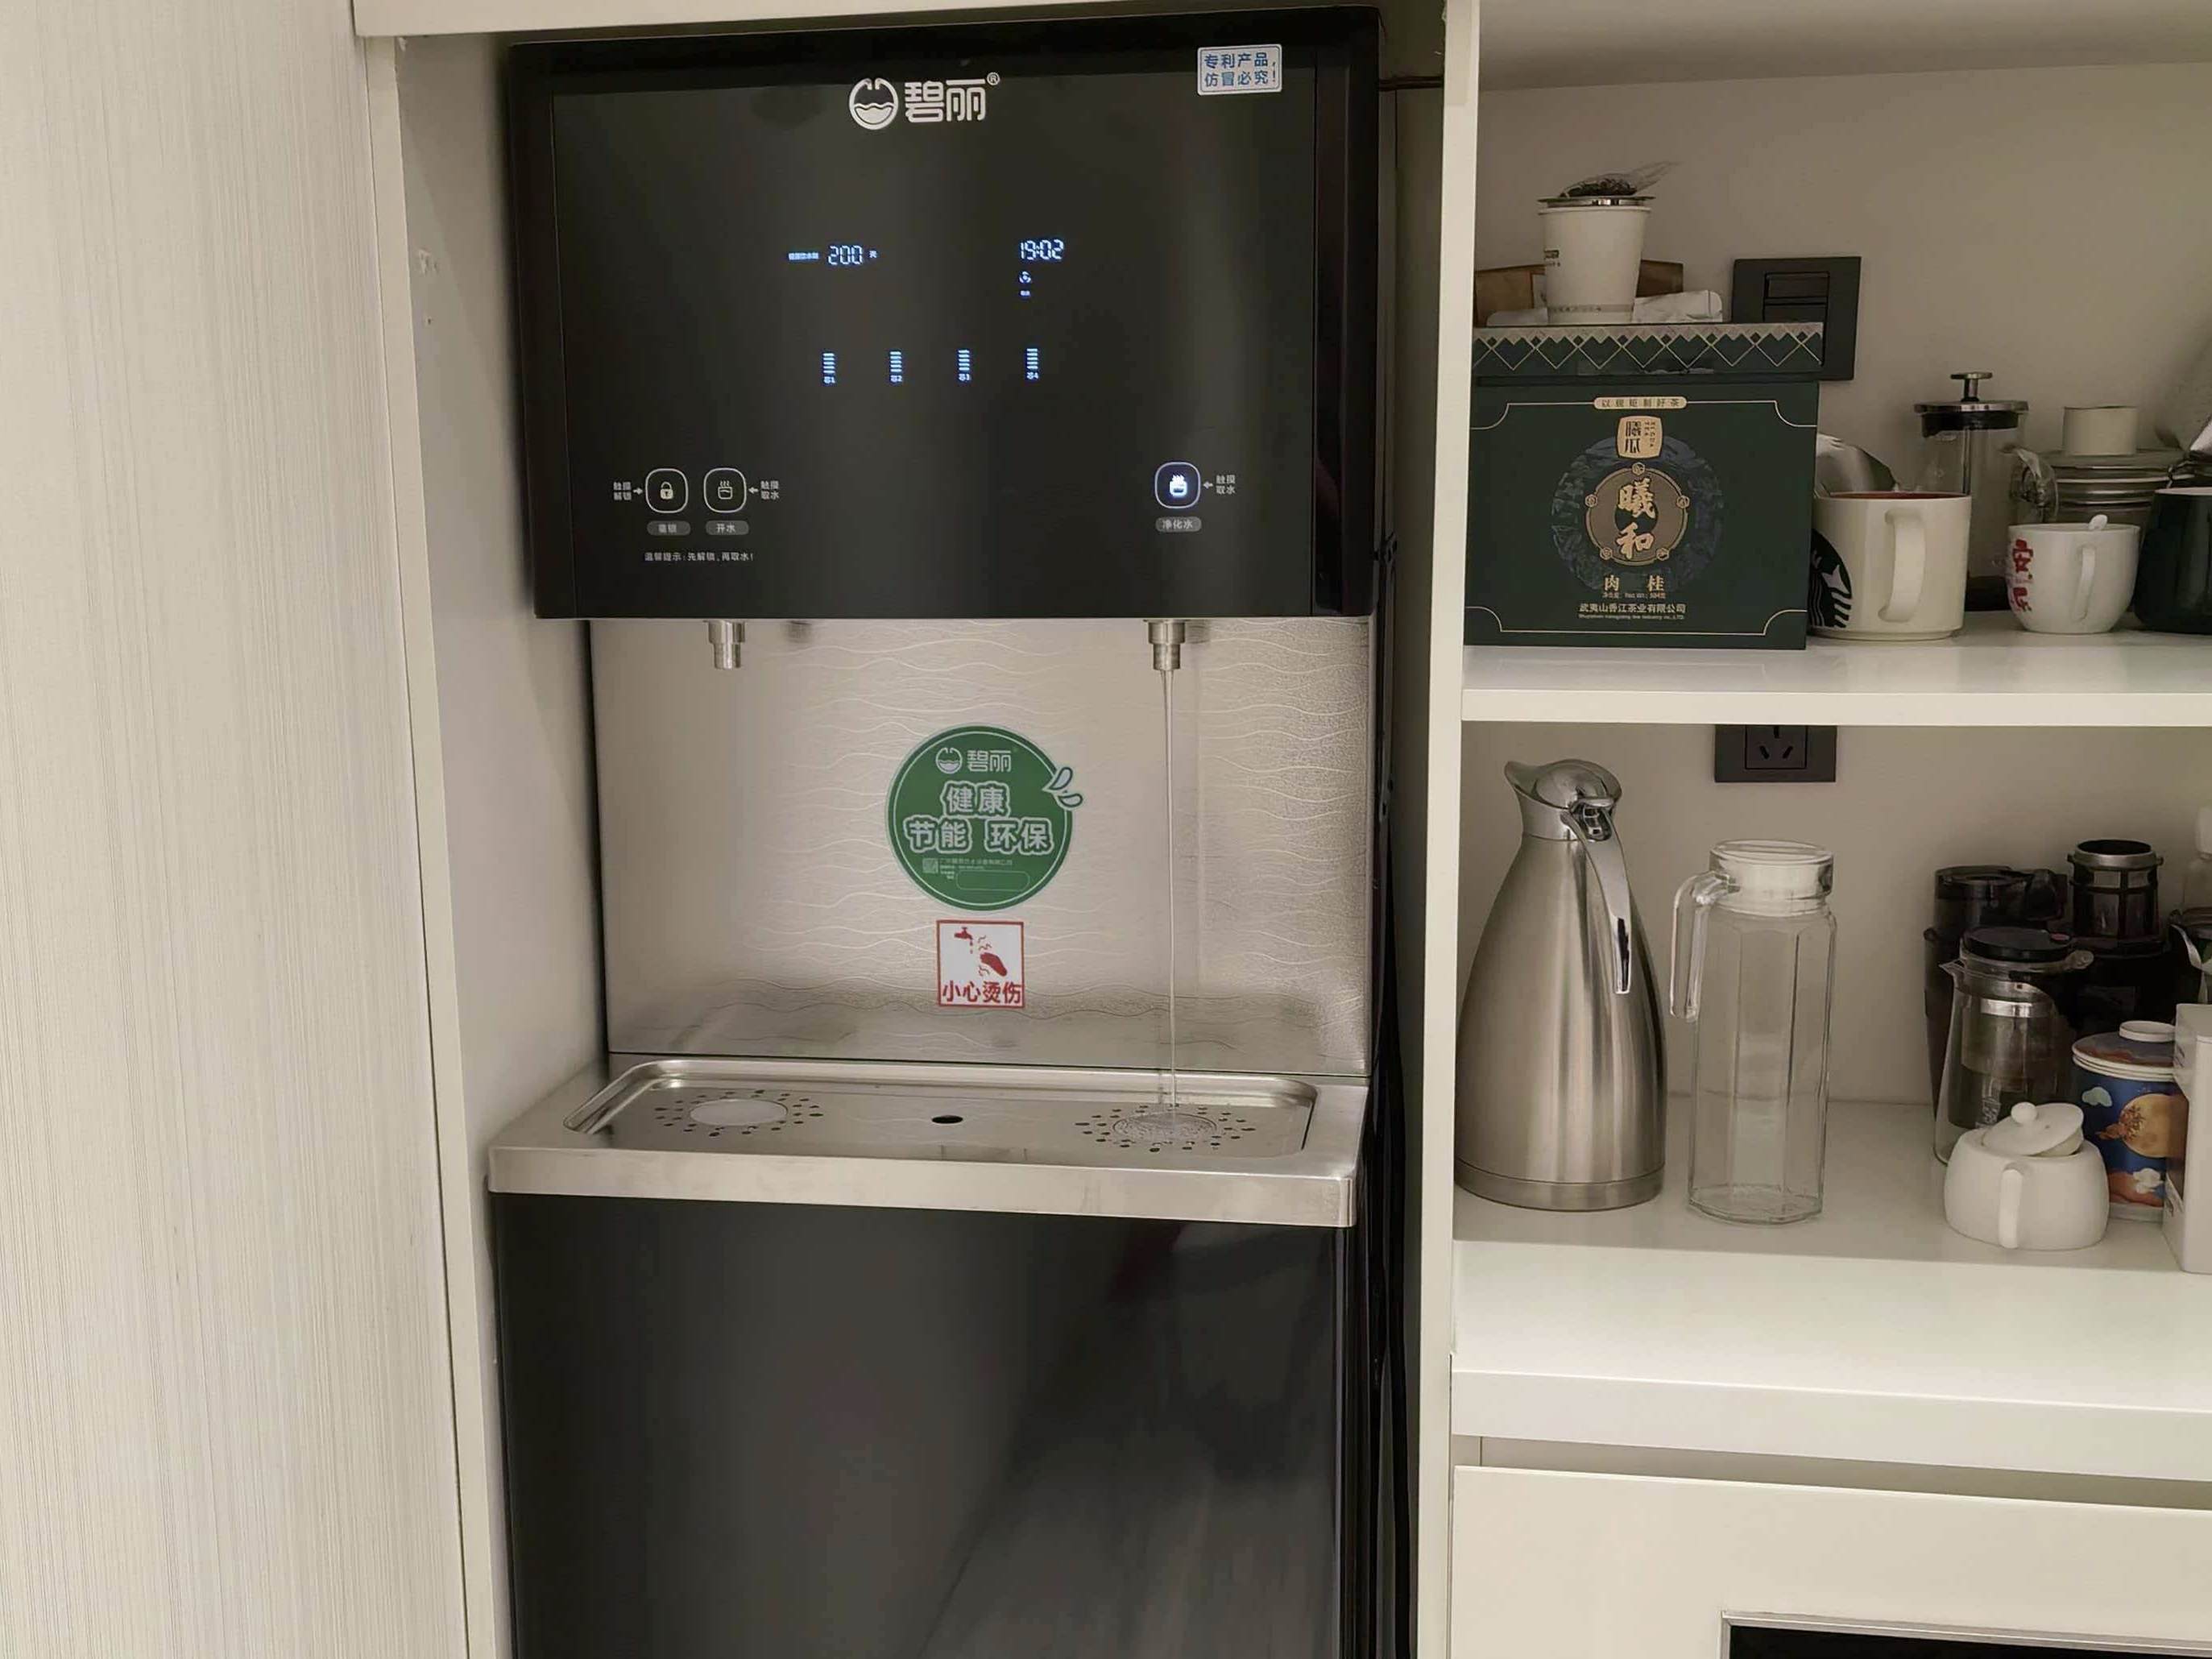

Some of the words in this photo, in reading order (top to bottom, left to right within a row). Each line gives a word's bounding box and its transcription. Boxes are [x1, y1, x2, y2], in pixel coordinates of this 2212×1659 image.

[1204, 52, 1268, 68] 专利产品
[905, 79, 986, 122] 碧丽
[828, 245, 863, 264] 200
[1020, 238, 1064, 260] 19:02
[716, 523, 735, 533] 开水
[1162, 519, 1193, 529] 净化水
[1604, 574, 1665, 591] 肉桂
[967, 749, 1012, 772] 碧丽
[945, 784, 1006, 815] 健康
[908, 819, 967, 848] 节能
[990, 820, 1052, 851] 环保
[942, 980, 1021, 1005] 小心烫伤
